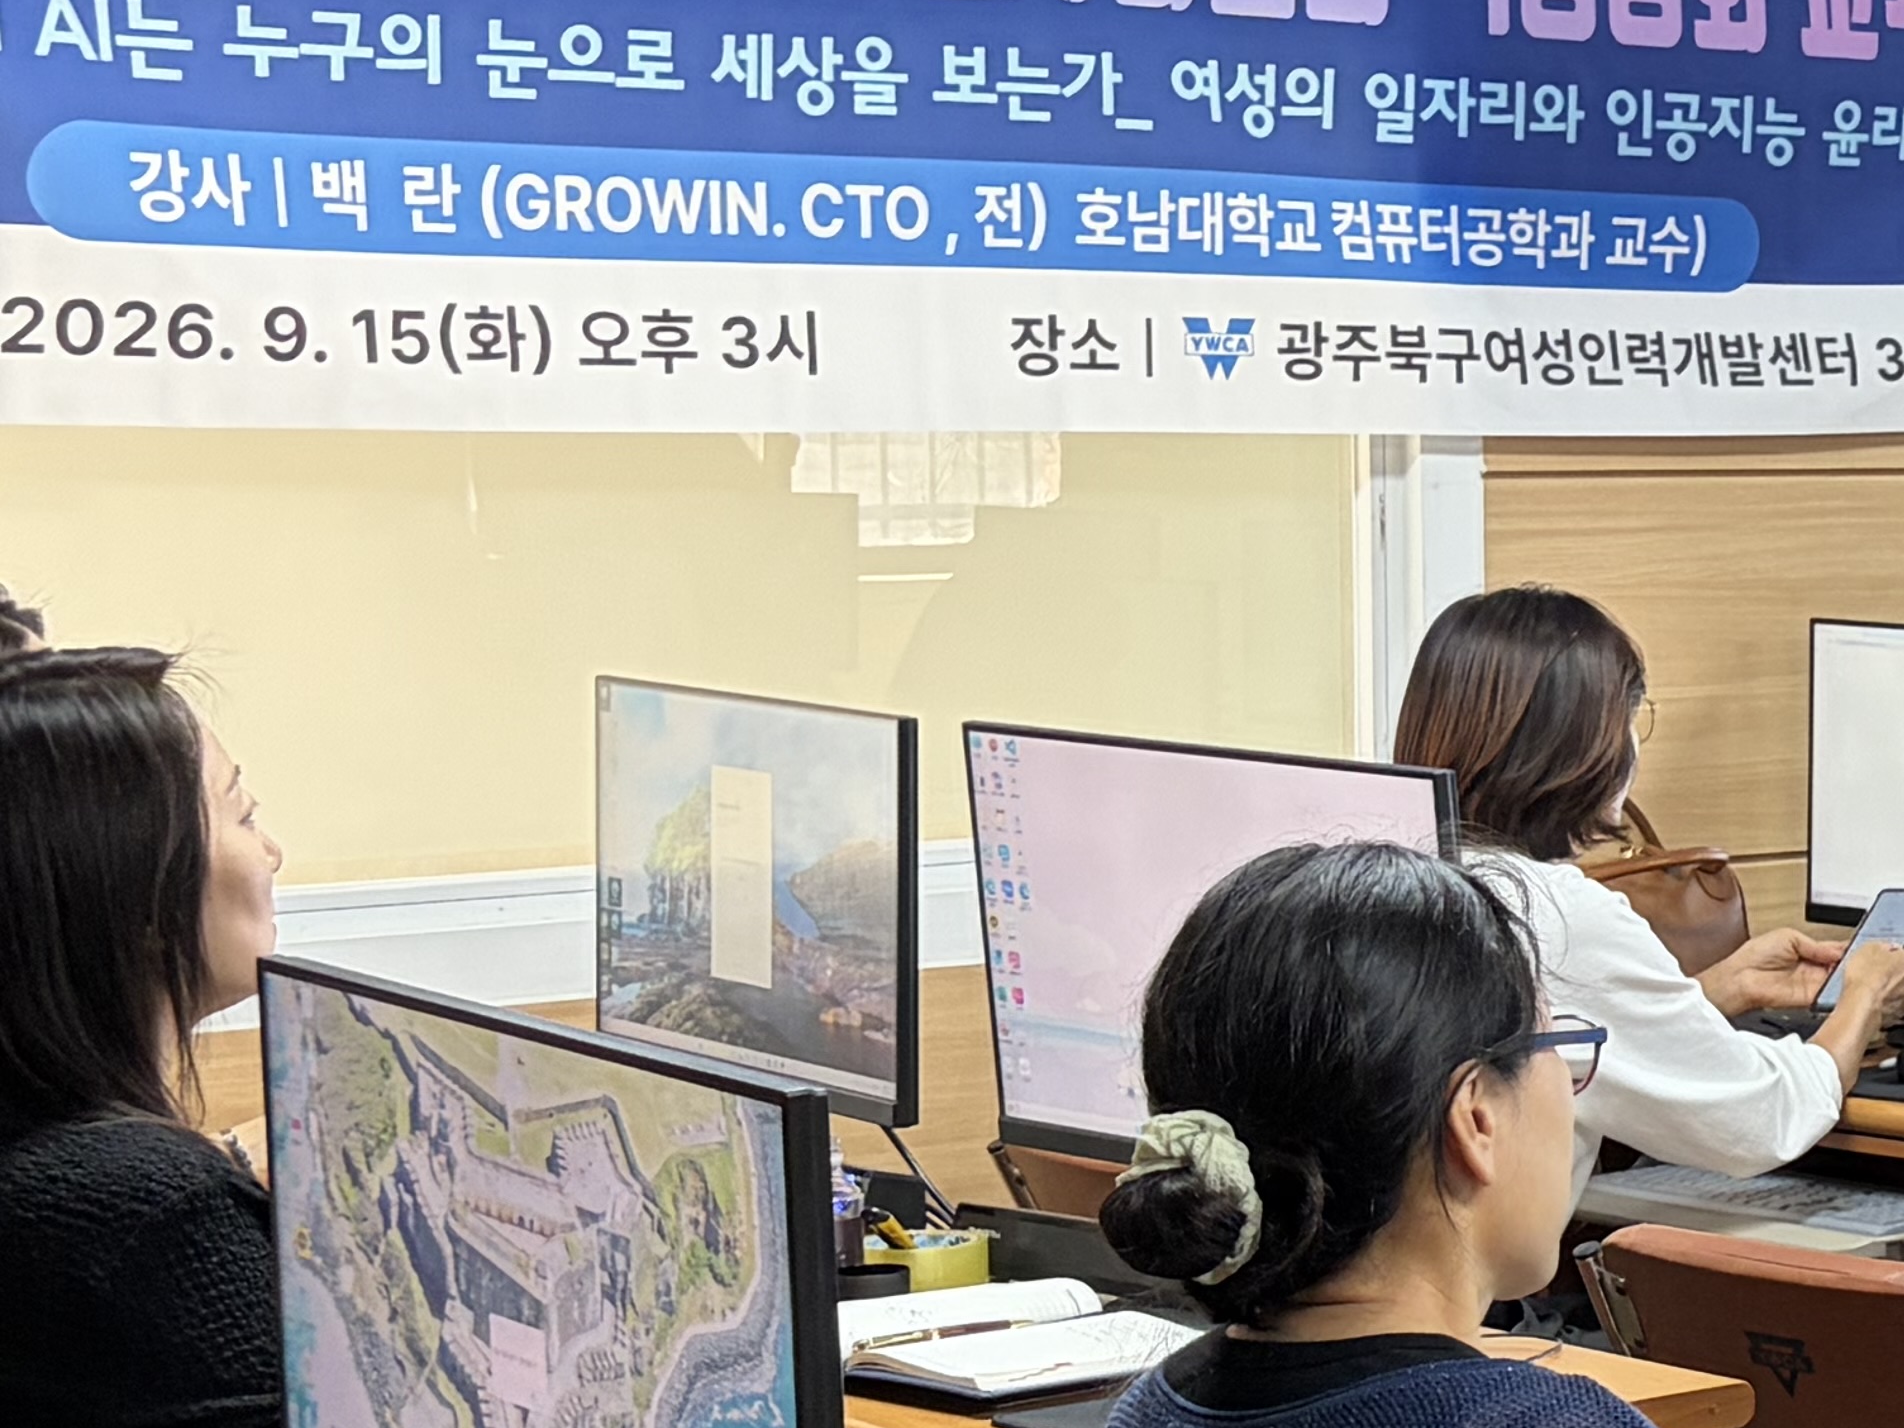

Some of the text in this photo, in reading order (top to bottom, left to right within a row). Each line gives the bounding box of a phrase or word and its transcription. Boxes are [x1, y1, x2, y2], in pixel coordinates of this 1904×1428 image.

[222, 2, 443, 85] 누구의
[474, 18, 685, 102] 눈으로
[709, 30, 910, 118] 세상을
[1170, 58, 1335, 139] 여성의
[1364, 68, 1584, 144] 일자리와
[1605, 93, 1806, 169] 인공지능
[127, 150, 252, 227] 강사
[1074, 184, 1322, 260] 호남대학교
[1330, 196, 1595, 273] 컴퓨터공학과
[1607, 210, 1708, 278] 교수)
[0, 294, 1120, 379] 2026. 9. 15(화) 오후 3시 장소
[1190, 336, 1250, 353] YWCA
[1275, 318, 1859, 388] 광주북구여성인력개발센터
